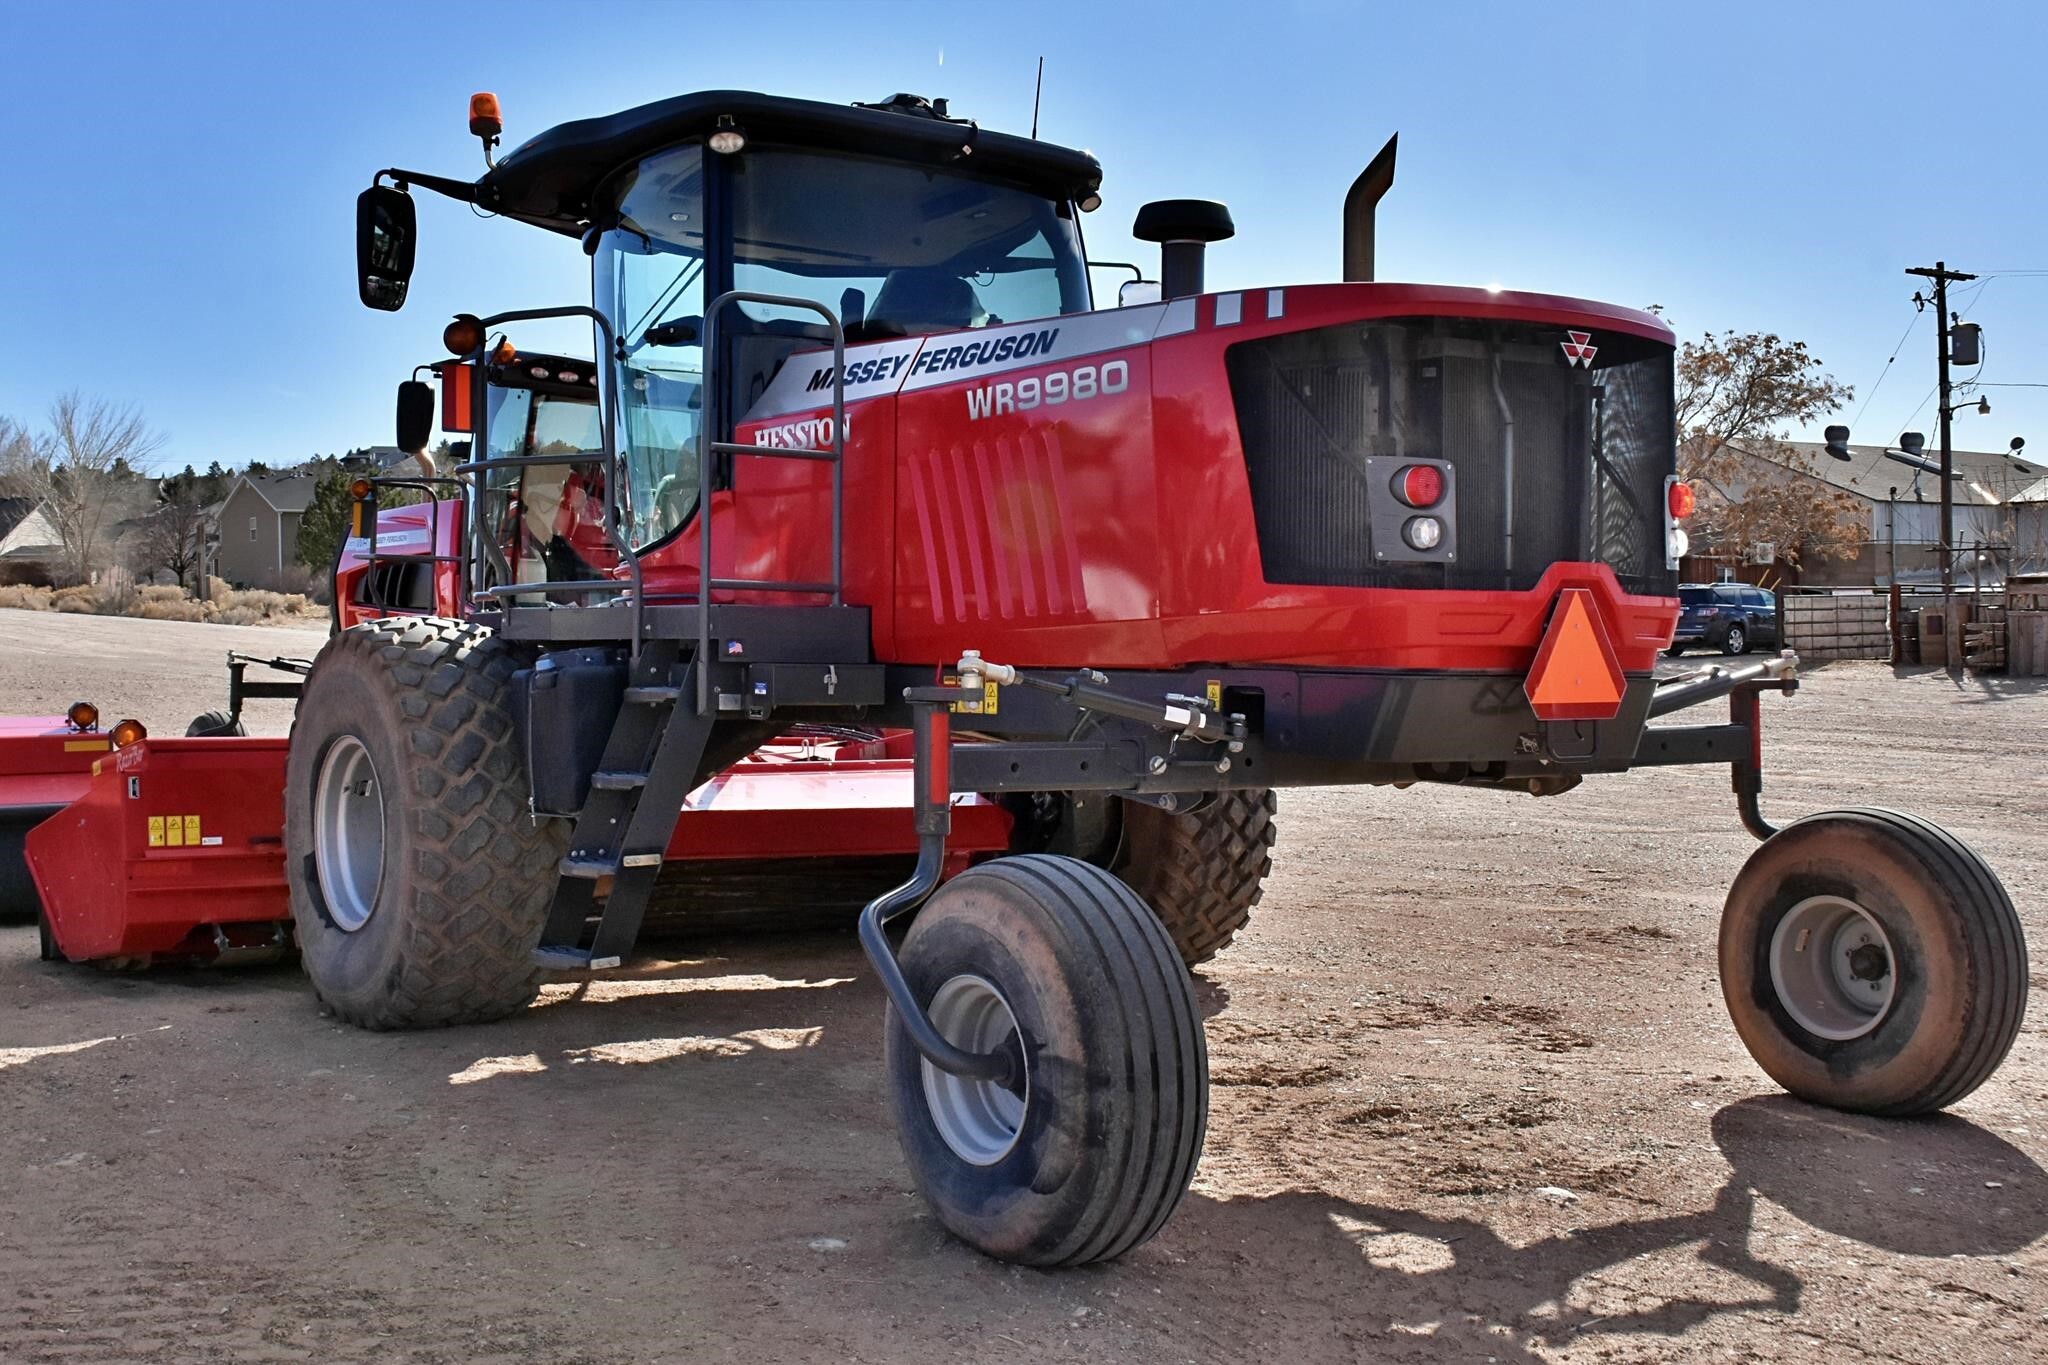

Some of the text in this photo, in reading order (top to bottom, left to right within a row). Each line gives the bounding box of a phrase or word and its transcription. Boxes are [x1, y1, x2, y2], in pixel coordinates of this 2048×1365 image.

[806, 328, 1059, 392] MSSEY FERGUSON
[966, 360, 1128, 421] WR9980
